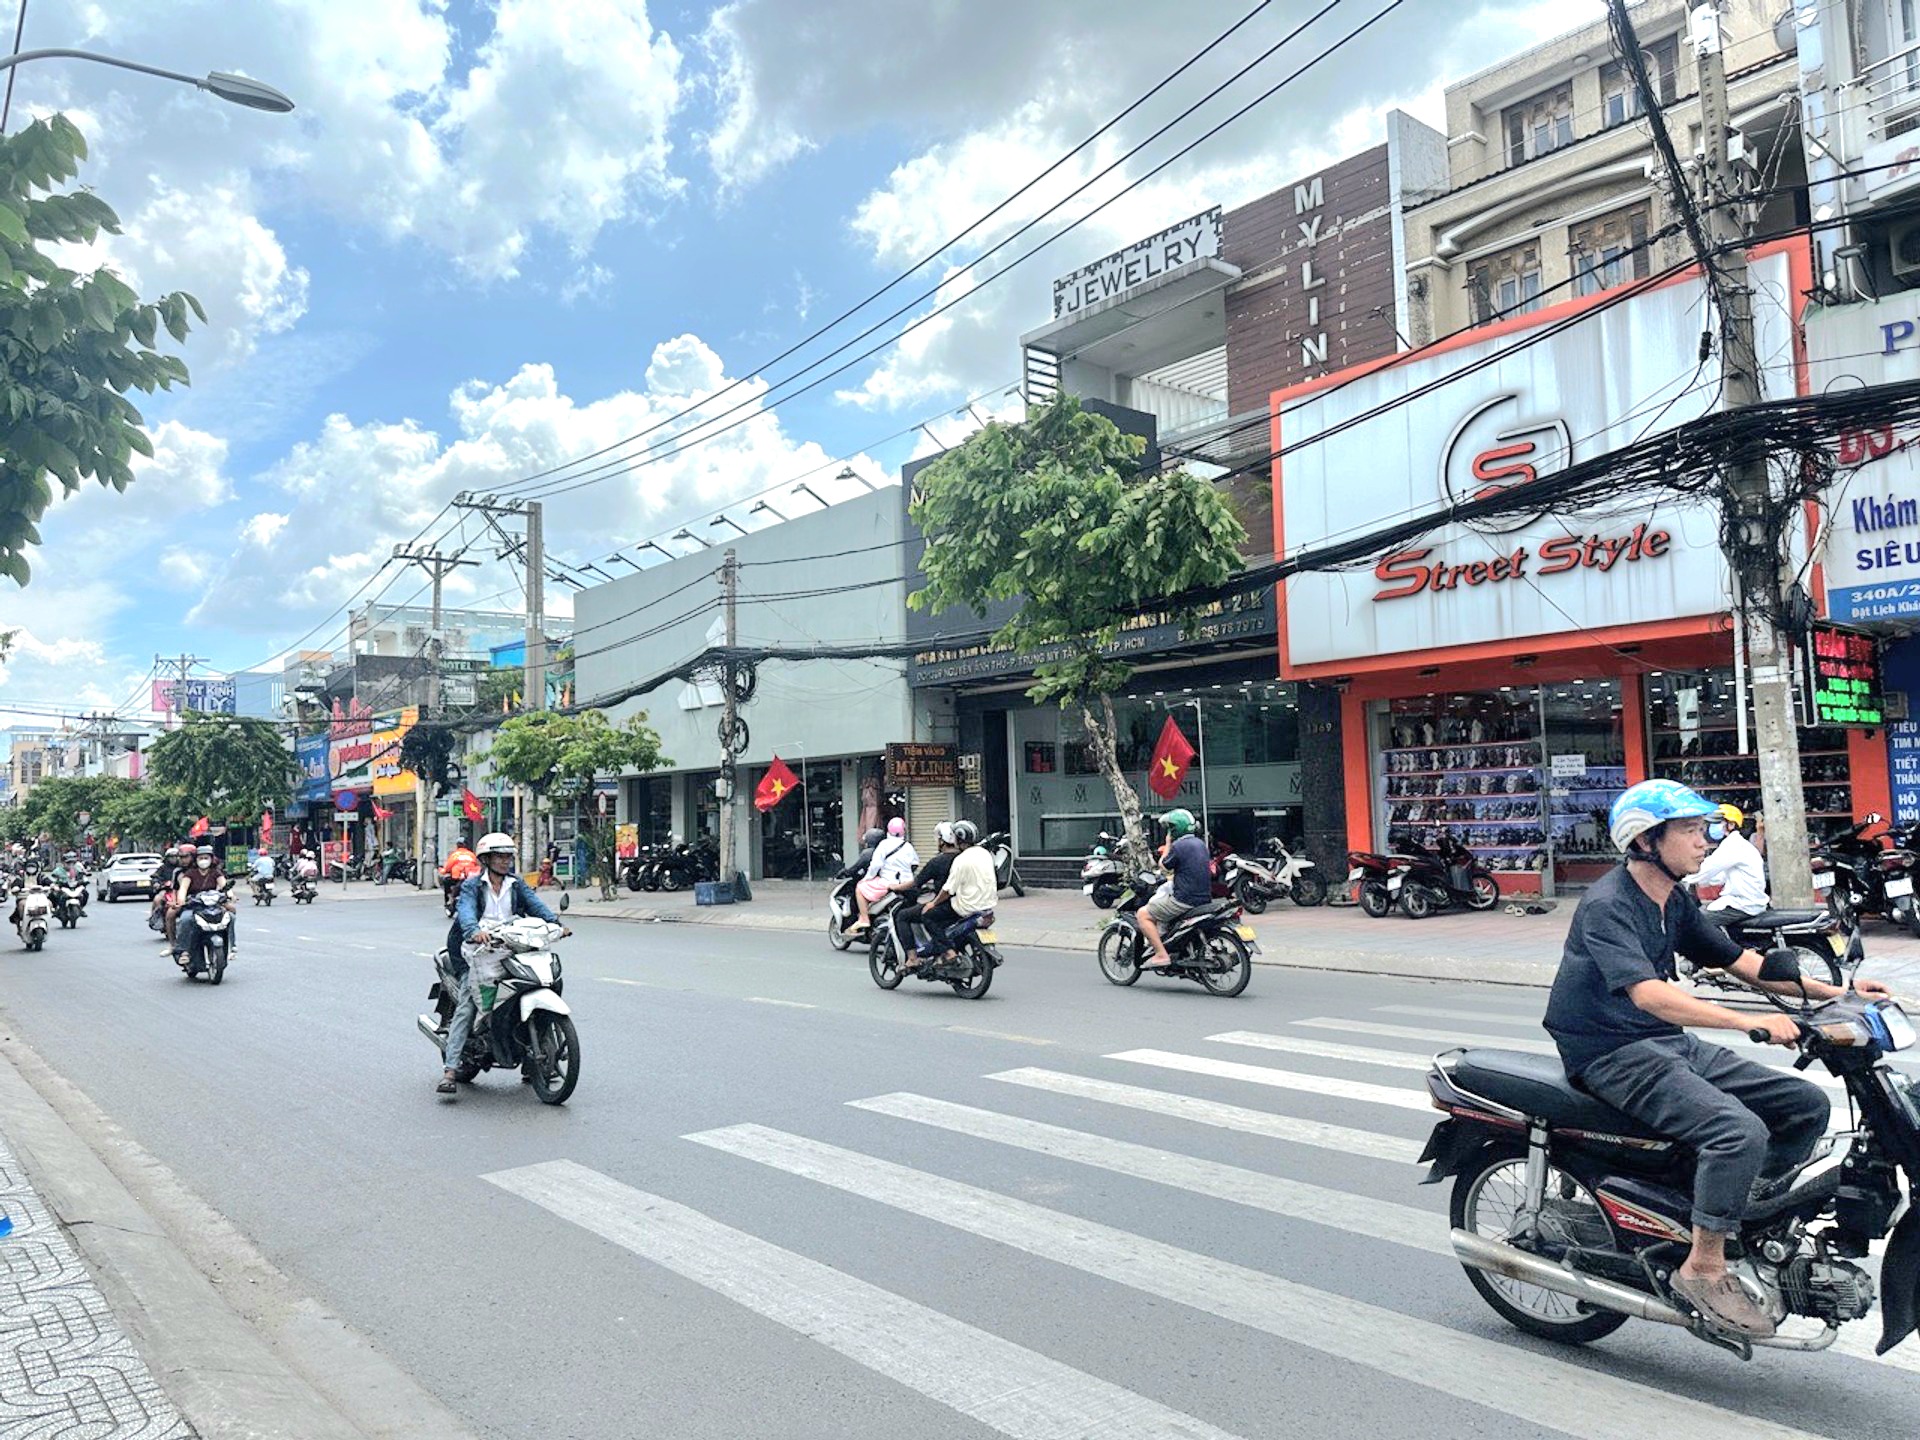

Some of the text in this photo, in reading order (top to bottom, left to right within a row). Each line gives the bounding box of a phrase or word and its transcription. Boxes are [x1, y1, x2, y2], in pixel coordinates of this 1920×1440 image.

[1067, 229, 1203, 313] JEWELRY
[1879, 319, 1920, 357] P
[1852, 494, 1919, 535] Khám
[1371, 523, 1671, 602] Street Style
[1856, 540, 1920, 571] SIÊU
[1897, 600, 1920, 614] Khá
[1582, 1131, 1623, 1145] HONDA
